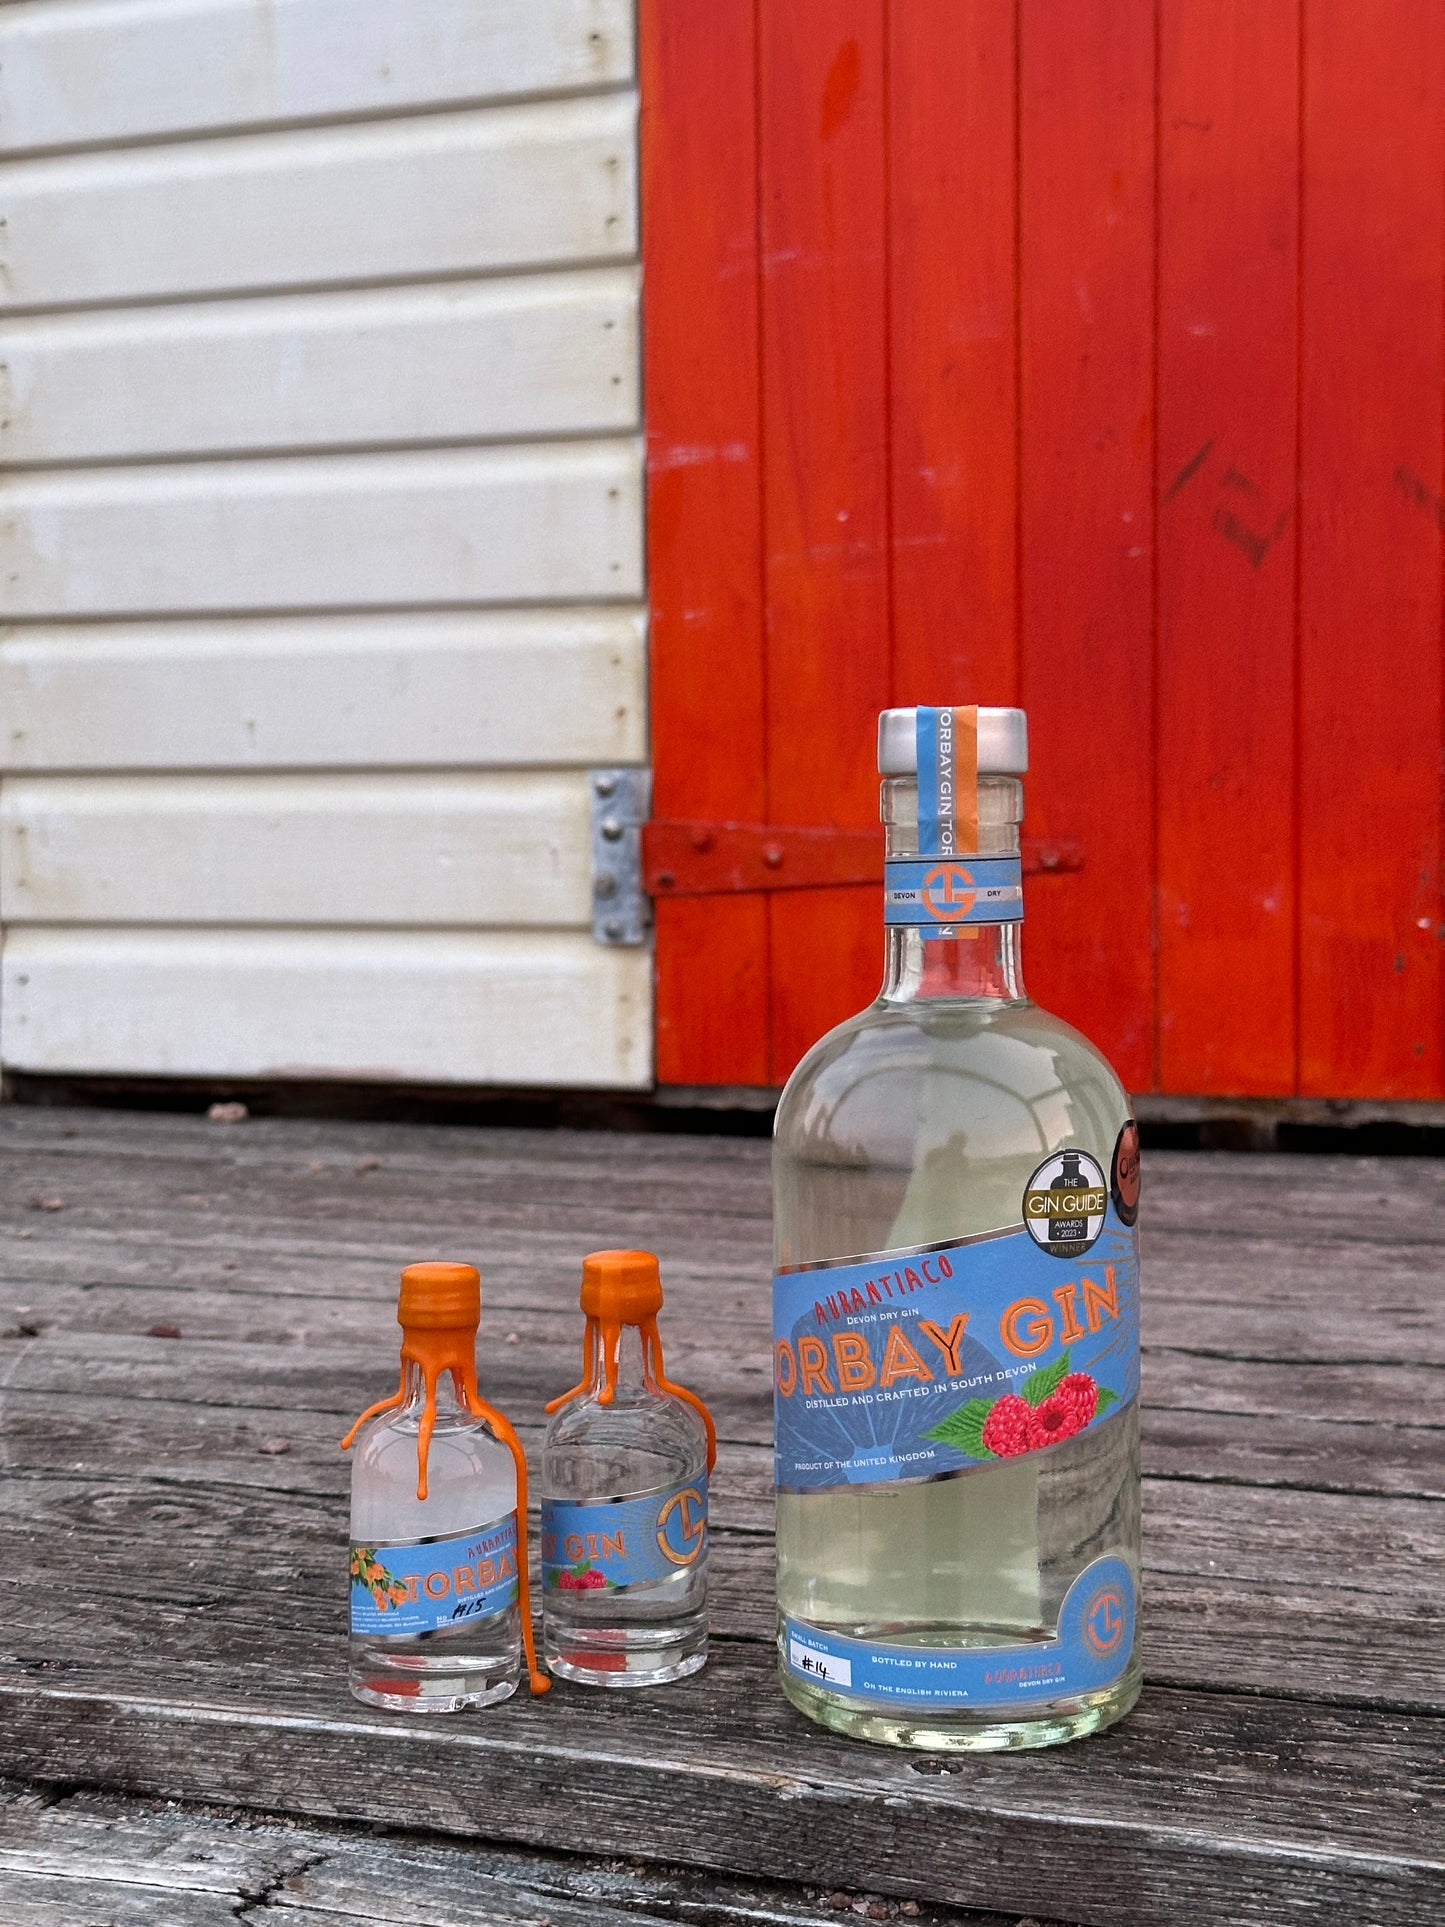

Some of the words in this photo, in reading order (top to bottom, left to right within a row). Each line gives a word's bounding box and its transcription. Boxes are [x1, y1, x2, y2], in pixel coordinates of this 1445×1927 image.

[940, 782, 952, 815] GIN
[987, 887, 1002, 897] DRY
[1063, 1178, 1078, 1187] THE
[1028, 1196, 1059, 1214] GIN
[1062, 1193, 1104, 1213] GUIDE
[1054, 1220, 1083, 1229] AWARDS
[1061, 1228, 1077, 1238] 2023
[1049, 1242, 1087, 1253] WINNER
[814, 1254, 954, 1326] AURANTIACO
[847, 1315, 877, 1325] DEVON
[880, 1311, 898, 1321] DRY
[901, 1308, 920, 1317] GIN
[774, 1312, 970, 1398] ORBAY
[1000, 1265, 1119, 1358] GIN
[805, 1397, 849, 1409] DISTILLED
[852, 1394, 874, 1405] AND
[876, 1386, 930, 1402] CRAFTED
[934, 1383, 947, 1393] IN
[951, 1374, 993, 1390] SOUTH
[996, 1362, 1037, 1380] DEVON
[795, 1462, 822, 1471] PRODUCT
[836, 1460, 852, 1468] THE
[854, 1456, 887, 1468] UNITED
[889, 1450, 935, 1463] KINGDOM
[564, 1529, 627, 1561] GIN
[802, 1655, 830, 1680] #14
[871, 1655, 912, 1668] BOTTLED
[863, 1681, 876, 1690] ON
[879, 1684, 893, 1693] THE
[895, 1687, 932, 1696] ENGLISH
[934, 1689, 969, 1697] RIVIERA
[1019, 1680, 1041, 1688] DEVON
